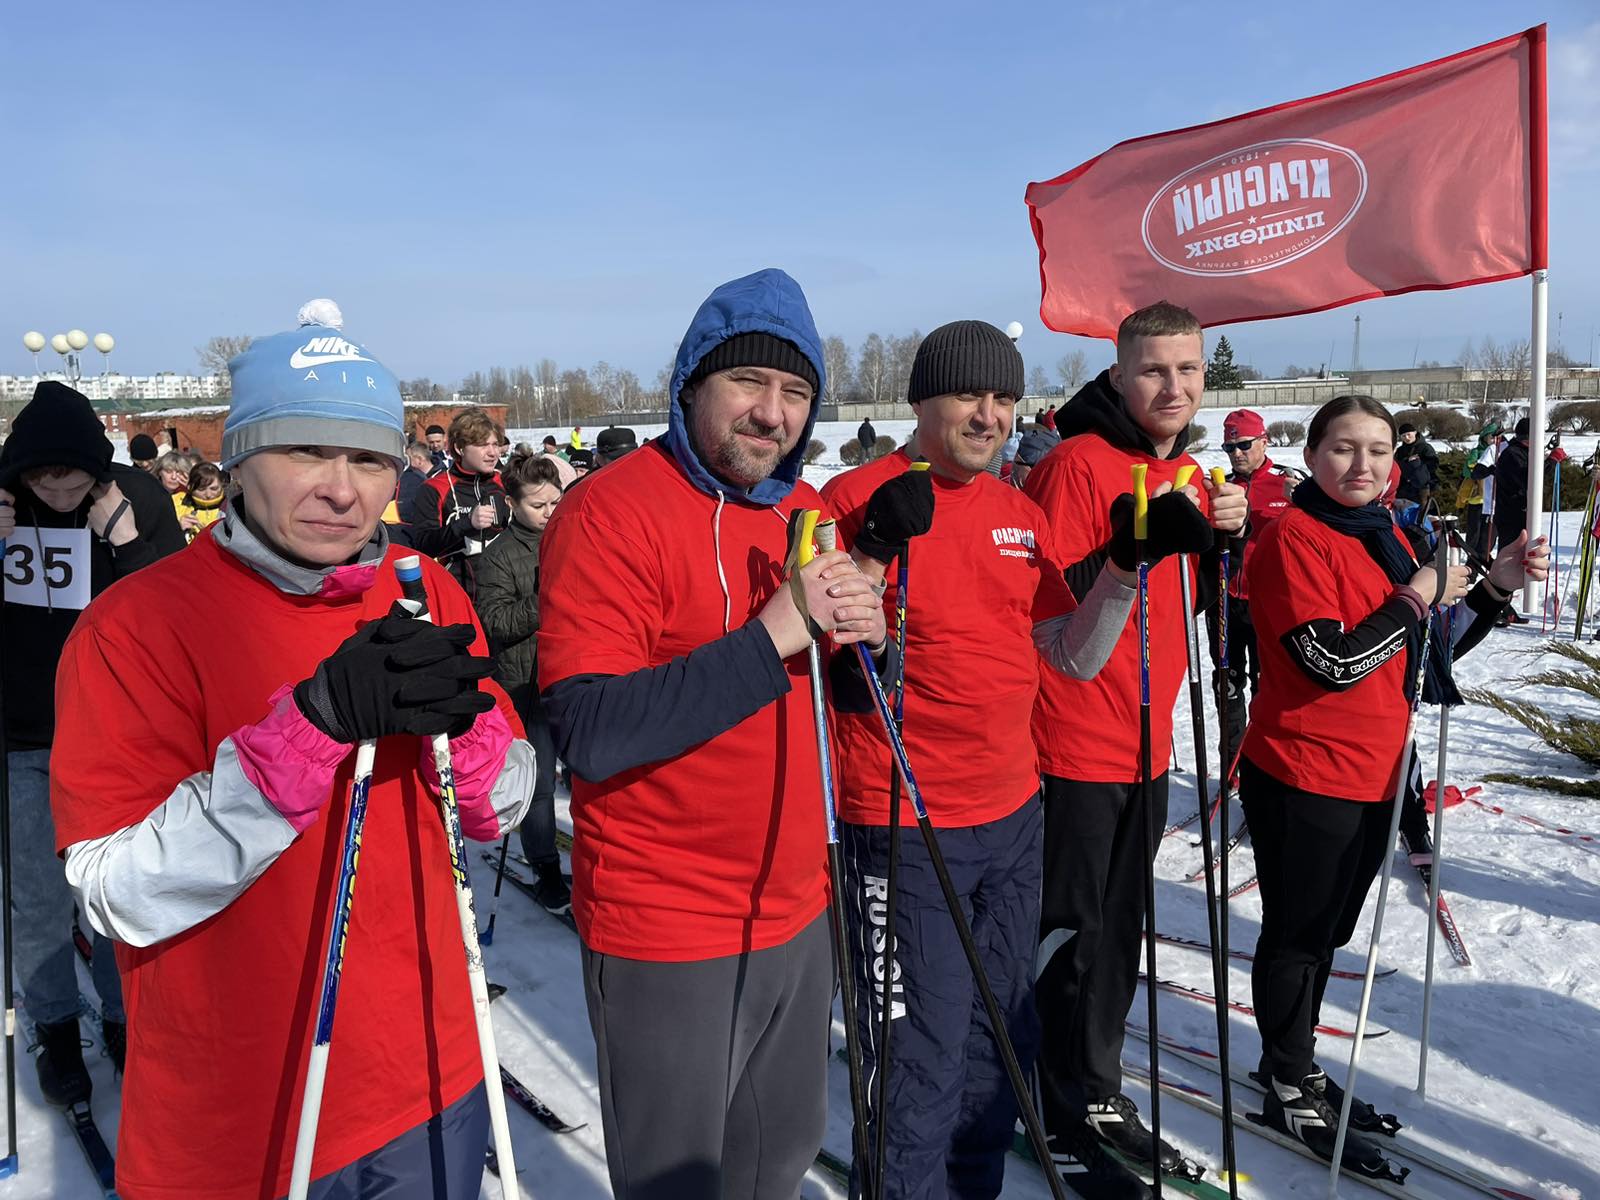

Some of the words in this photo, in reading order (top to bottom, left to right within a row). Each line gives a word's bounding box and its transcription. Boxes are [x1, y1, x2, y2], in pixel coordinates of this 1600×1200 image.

[302, 336, 360, 356] NIKE
[303, 369, 377, 390] AIR
[4, 543, 73, 589] 35
[863, 875, 907, 1022] RUSSIA
